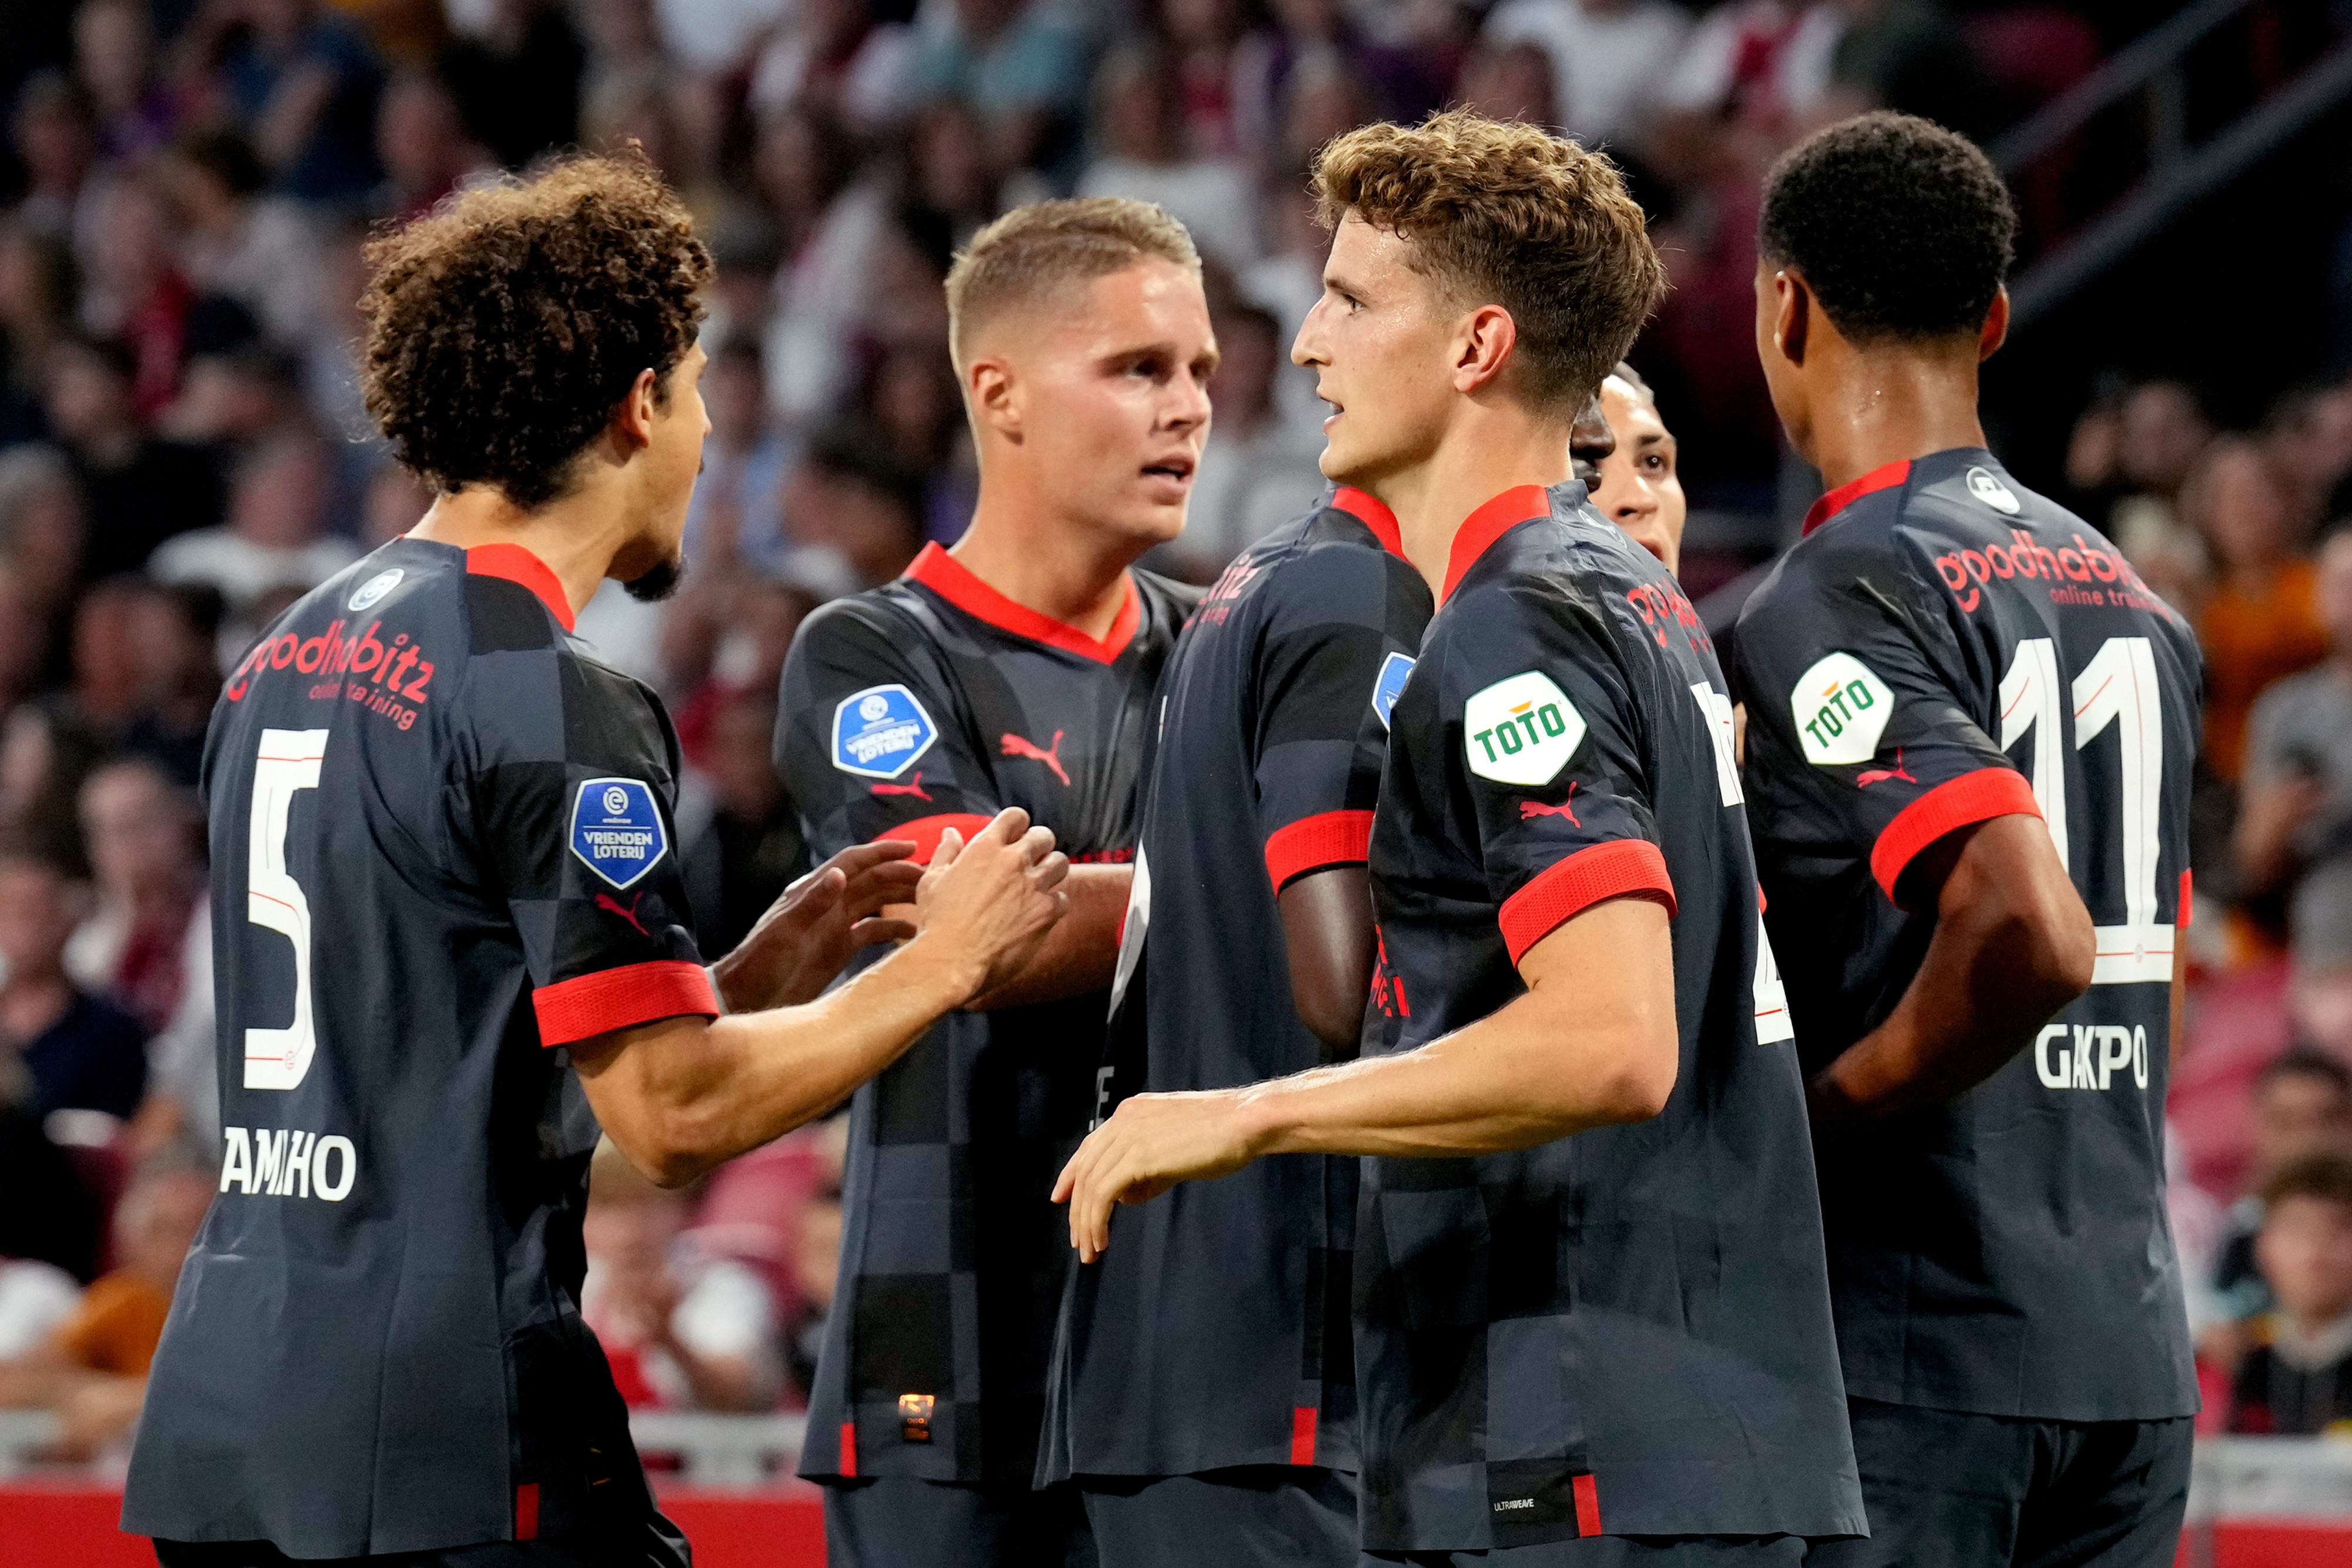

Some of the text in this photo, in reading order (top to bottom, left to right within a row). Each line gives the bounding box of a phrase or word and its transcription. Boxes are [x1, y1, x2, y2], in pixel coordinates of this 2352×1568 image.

[2050, 585, 2104, 606] online
[1473, 703, 1566, 763] TOTO
[1805, 680, 1874, 749] TOTO
[583, 831, 653, 845] VRIENDEN
[1999, 637, 2175, 984] 11
[593, 845, 646, 860] LOTERIJ
[243, 728, 330, 1090] 5
[219, 1126, 357, 1202] AMHO
[1494, 1498, 1534, 1512] ULTRAWEAVE
